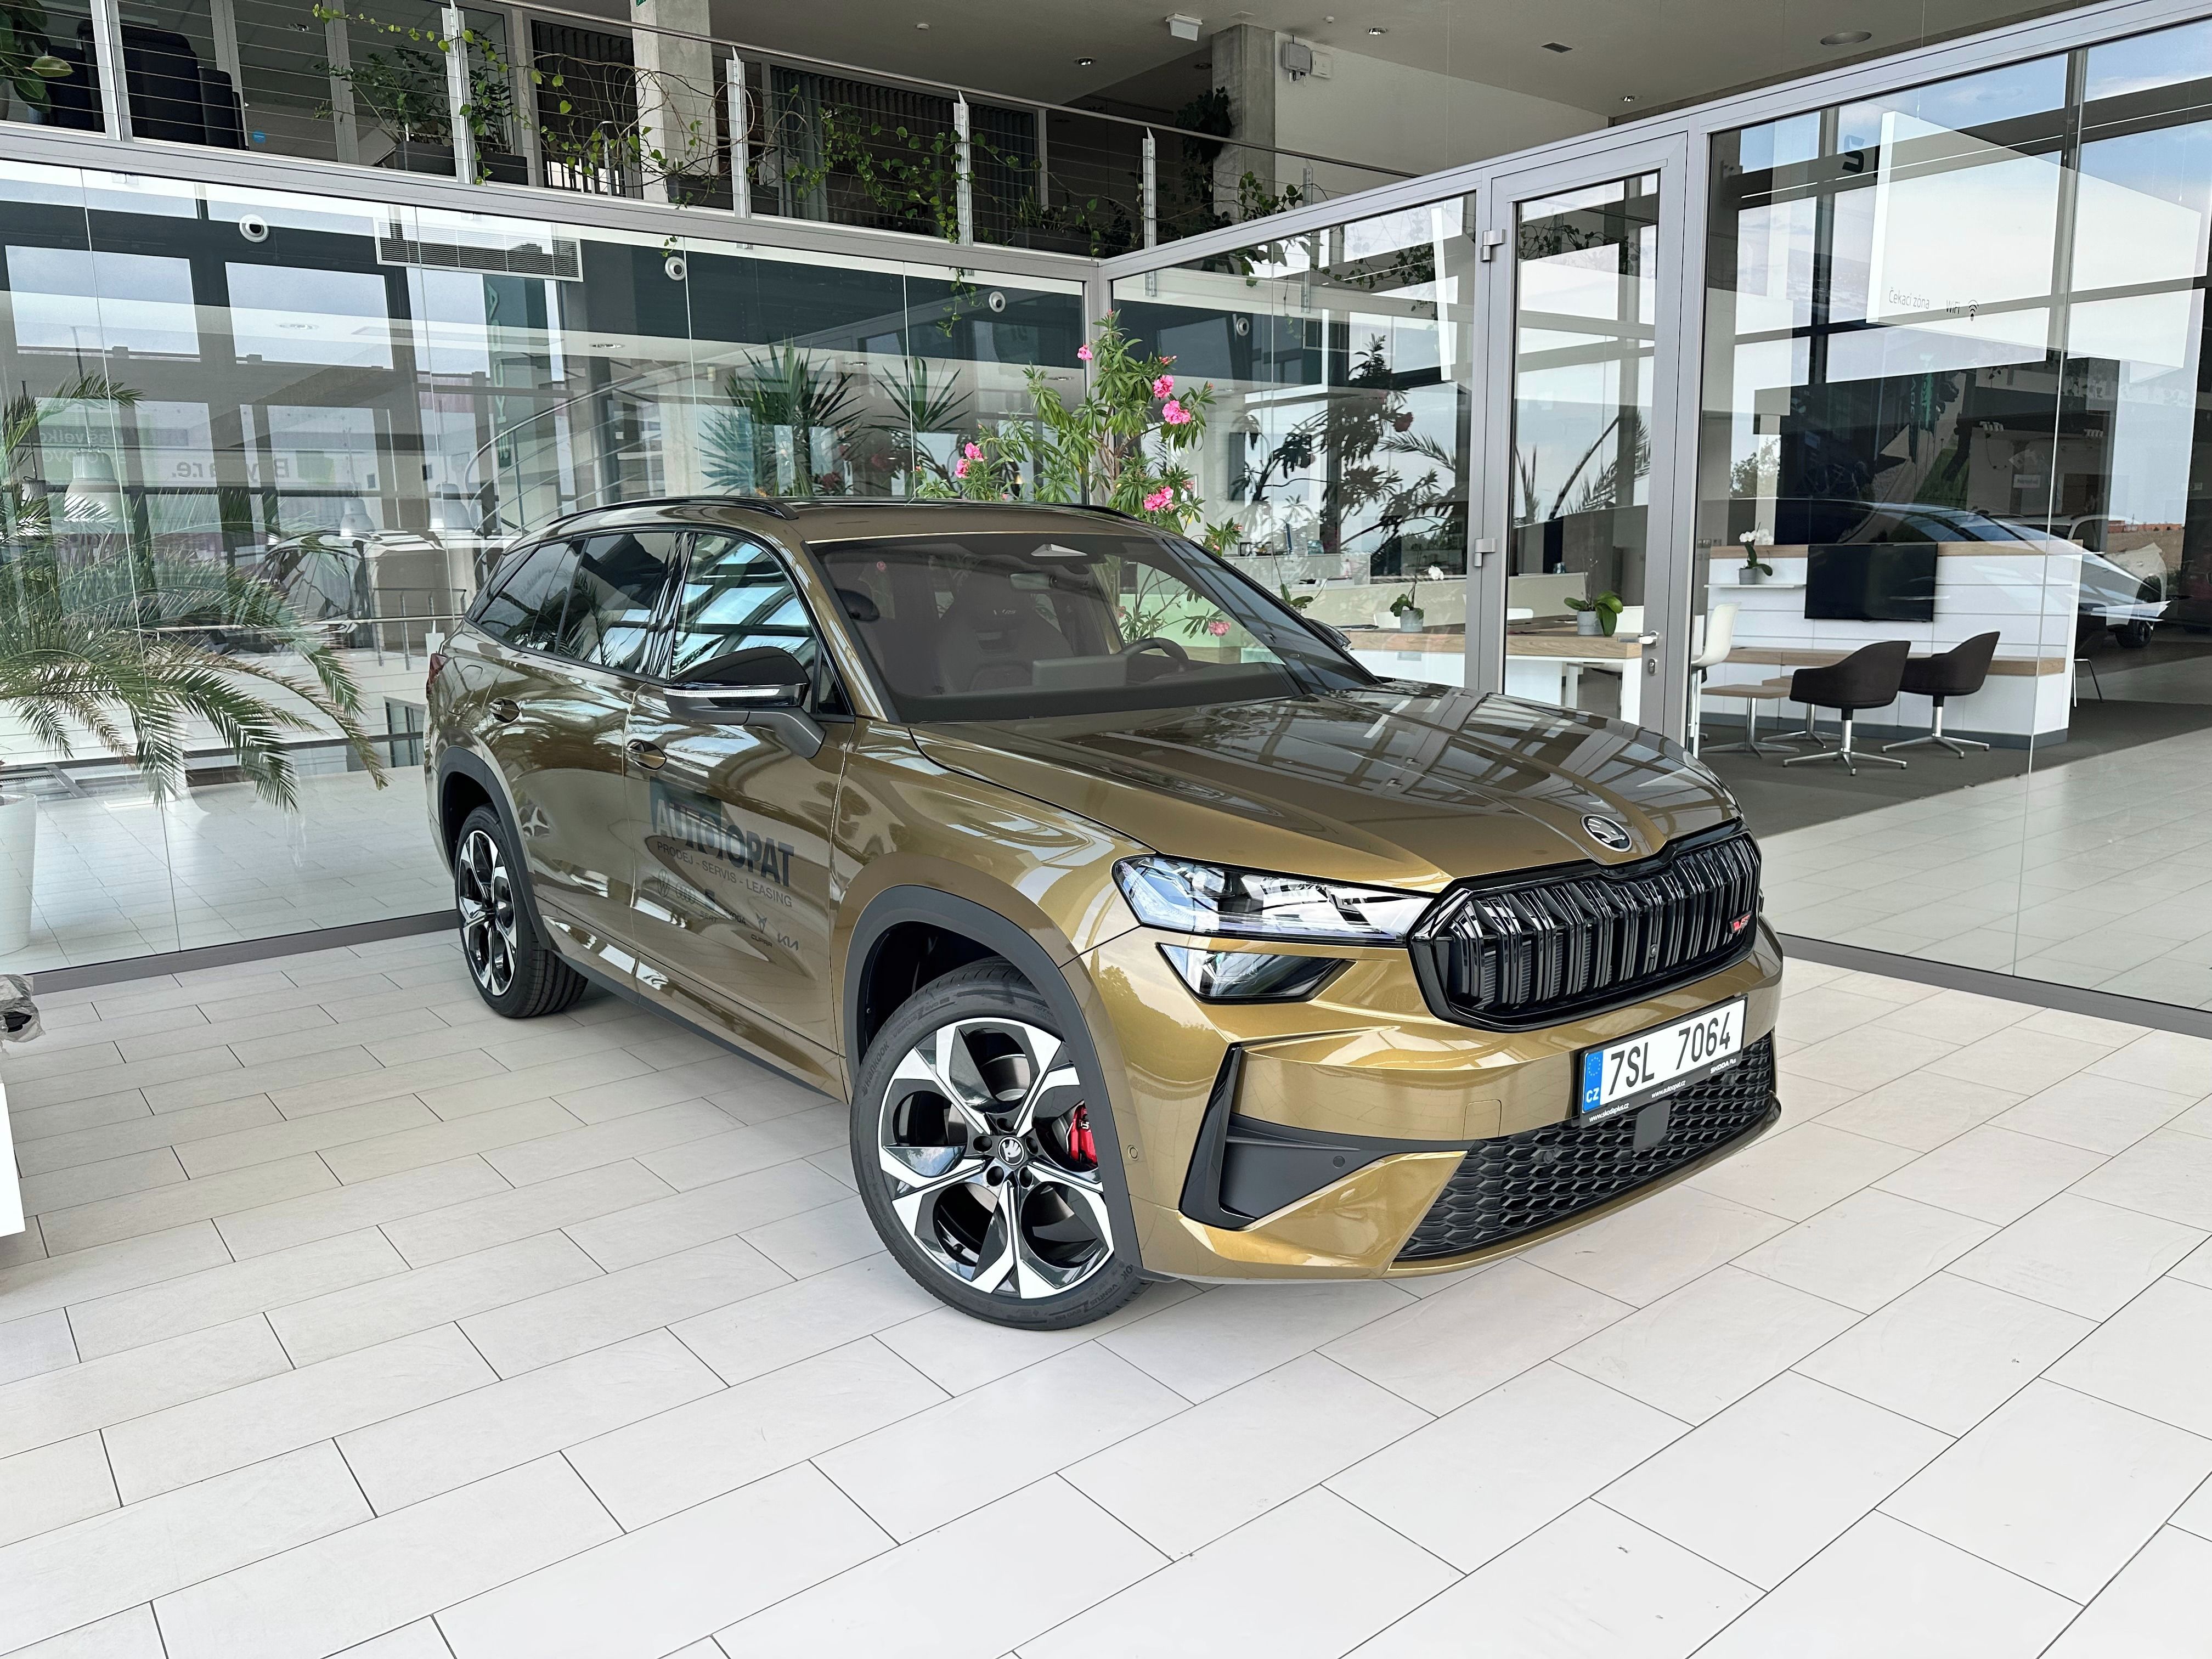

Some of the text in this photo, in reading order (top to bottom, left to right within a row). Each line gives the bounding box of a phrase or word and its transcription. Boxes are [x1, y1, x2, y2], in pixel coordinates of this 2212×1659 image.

[1889, 287, 1929, 309] Čekací zóna
[1946, 300, 1960, 314] WiFi
[657, 842, 693, 865] PRODEJ
[702, 860, 737, 883] SERVIS
[746, 878, 792, 907] LEASING
[751, 934, 772, 947] CUPRA
[777, 933, 799, 951] KIA
[1609, 1012, 1730, 1096] 7SL 7064
[1586, 1088, 1599, 1103] CZ
[1589, 1103, 1629, 1122] www.skodaplus.cz
